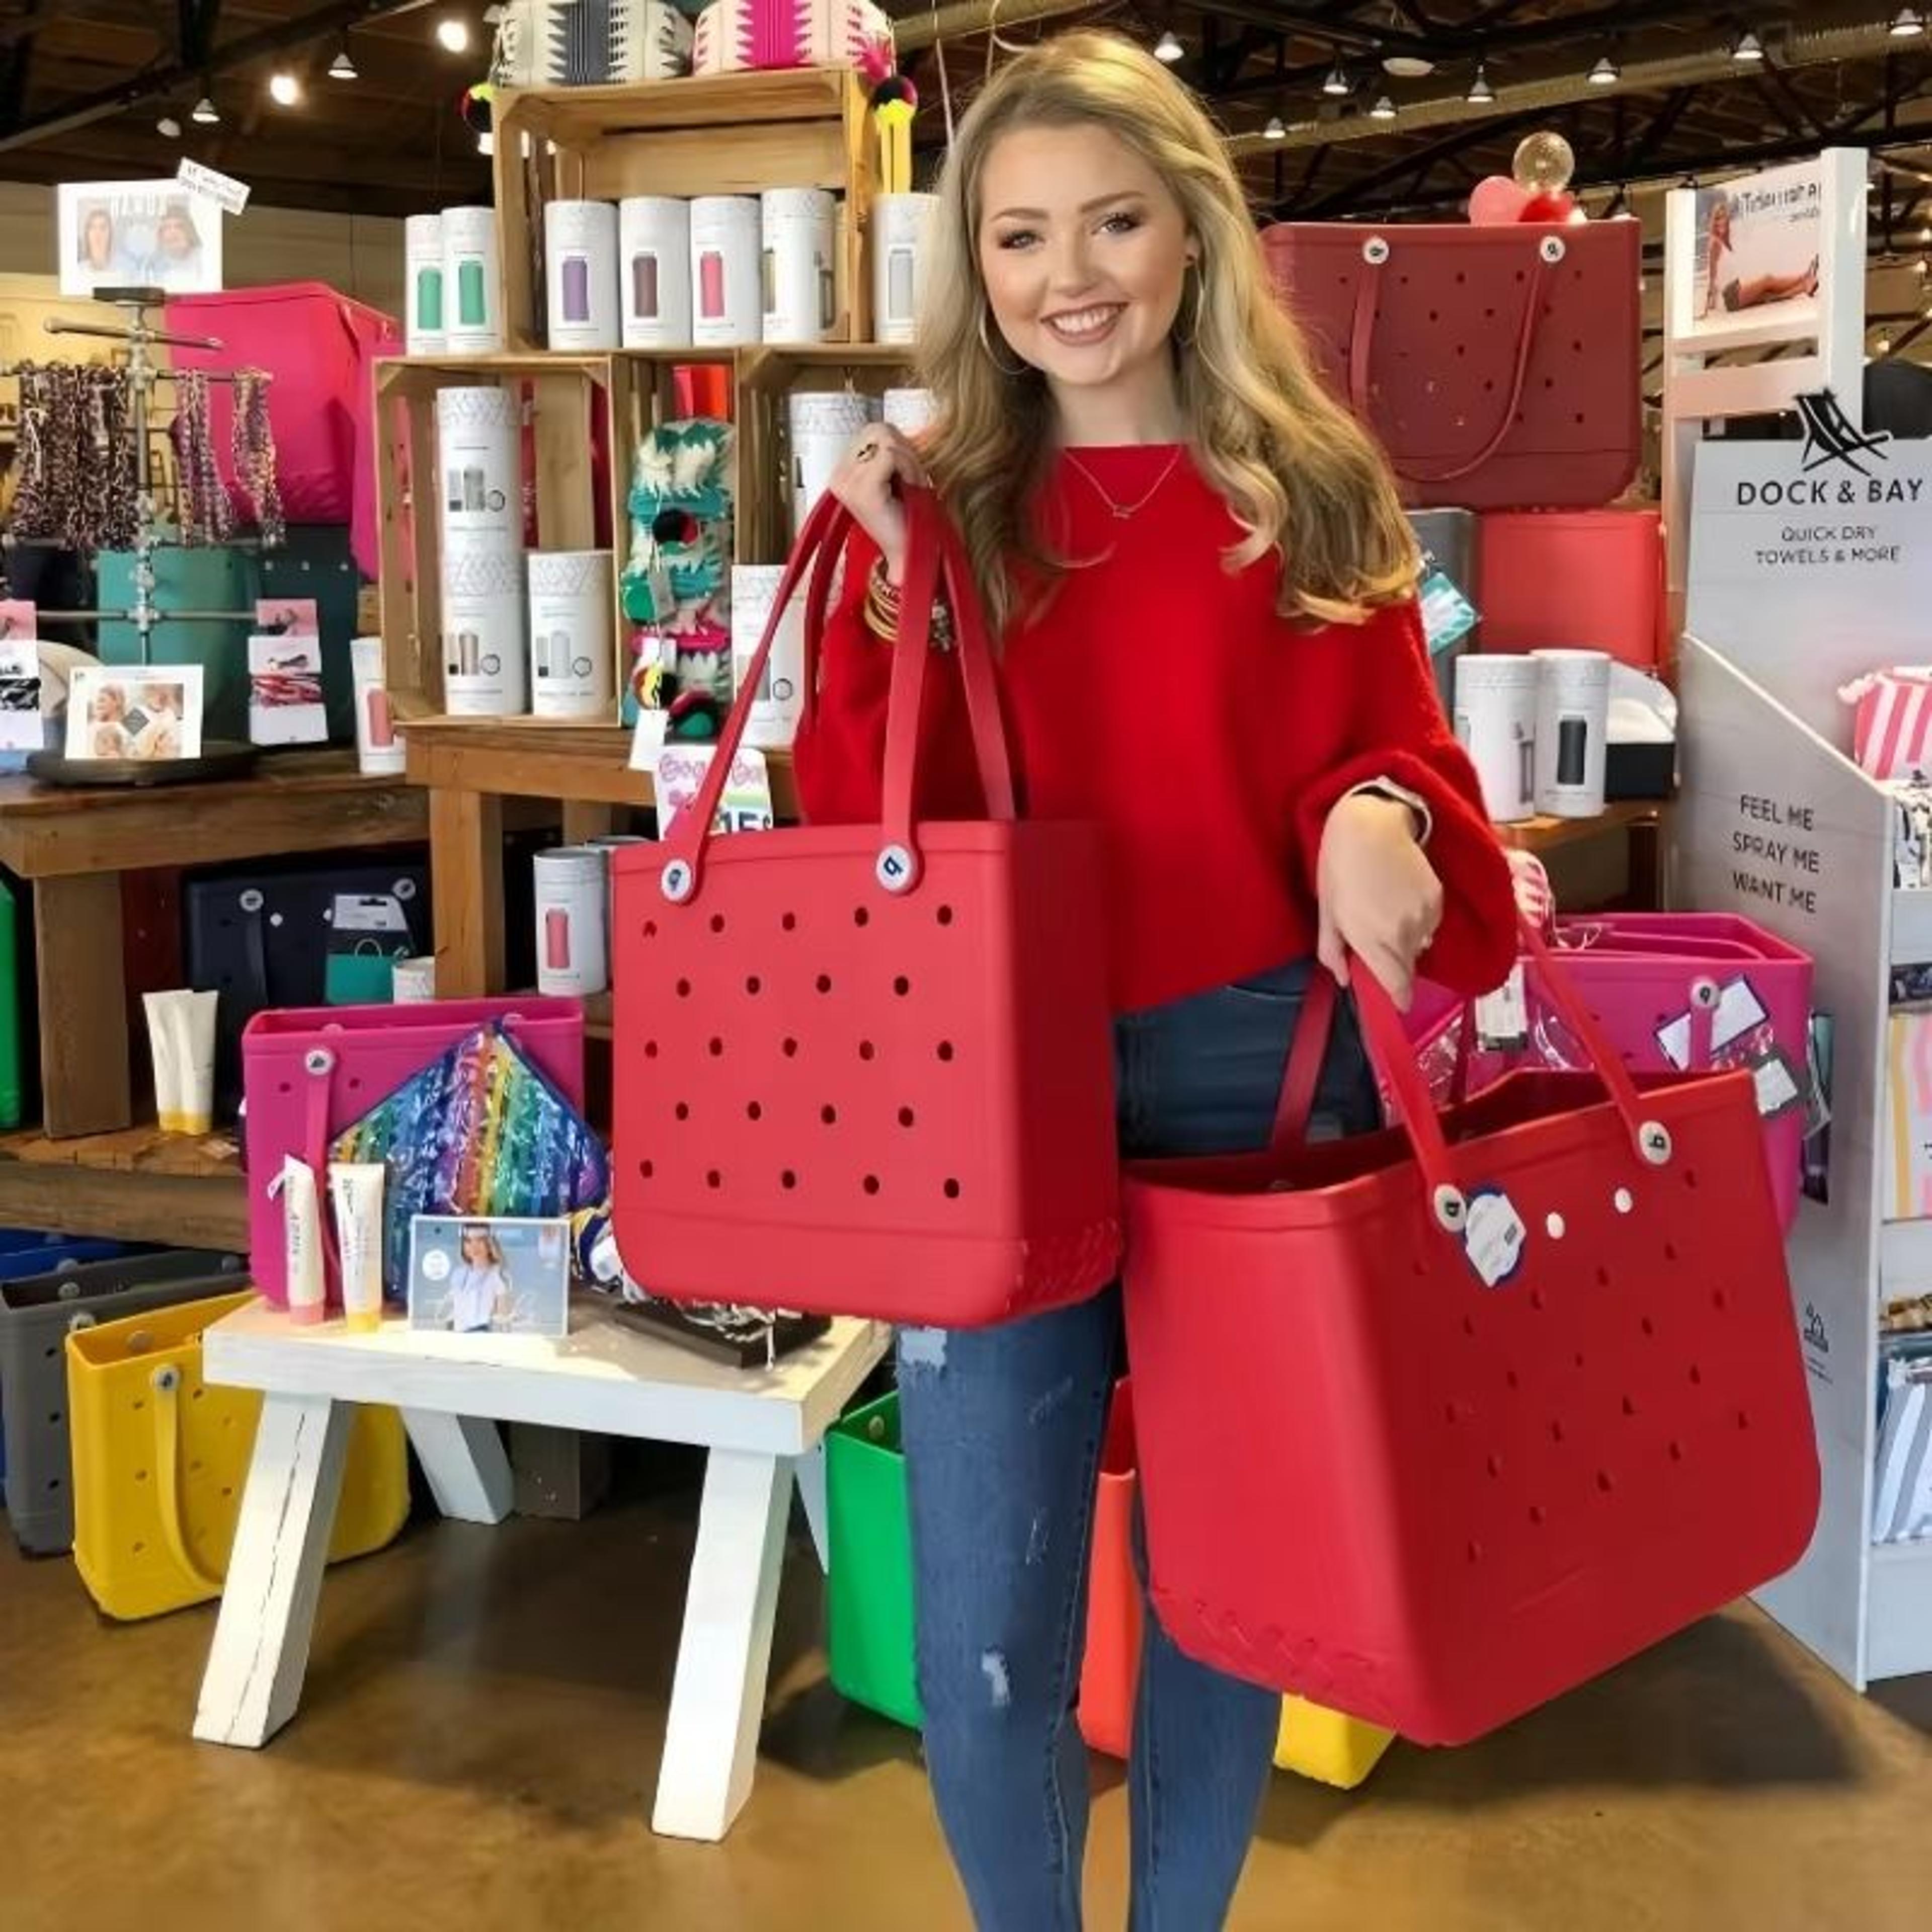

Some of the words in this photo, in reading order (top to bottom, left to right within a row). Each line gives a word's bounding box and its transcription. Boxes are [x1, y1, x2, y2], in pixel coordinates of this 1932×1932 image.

[1738, 480, 1828, 505] DOCK
[1837, 481, 1855, 504] &
[1868, 479, 1923, 503] BAY
[1782, 527, 1836, 542] QUICK
[1841, 526, 1877, 540] DRY
[1756, 548, 1828, 564] TOWELS
[1835, 549, 1846, 561] &
[1852, 546, 1901, 561] MORE
[1741, 795, 1783, 824] FEEL
[1789, 808, 1814, 831] ME
[1733, 833, 1789, 865] SPRAY
[1795, 848, 1820, 872] ME
[1733, 871, 1787, 903] WANT
[1790, 888, 1816, 913] ME
